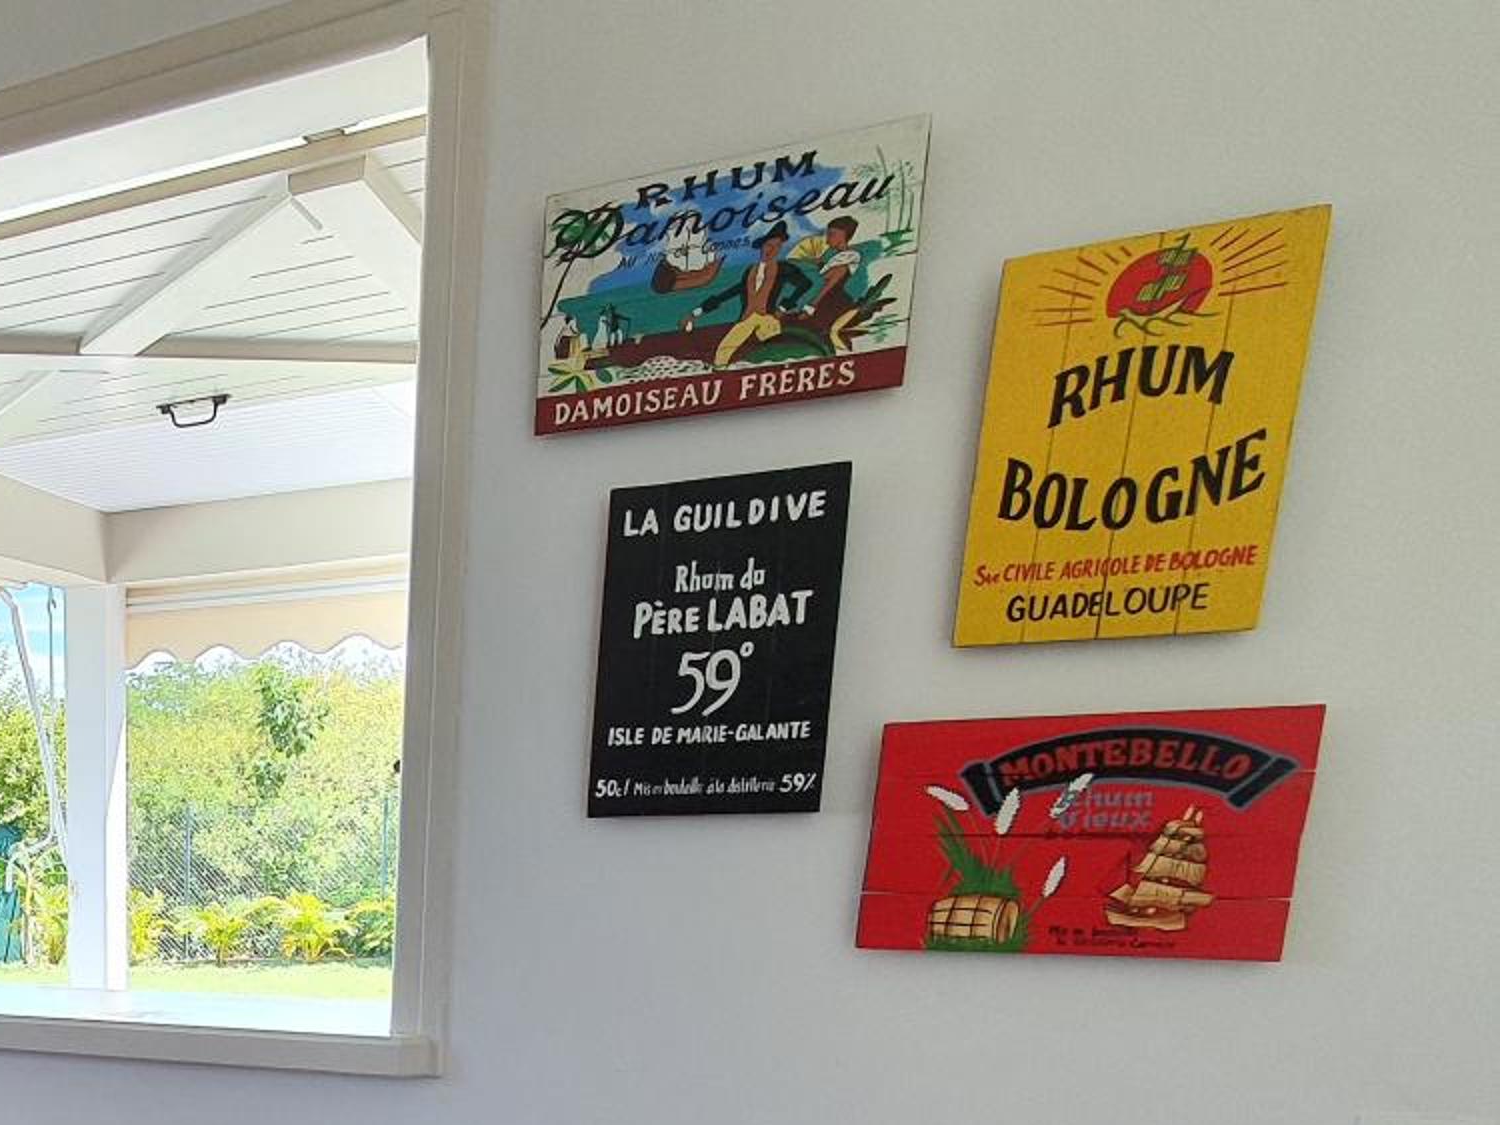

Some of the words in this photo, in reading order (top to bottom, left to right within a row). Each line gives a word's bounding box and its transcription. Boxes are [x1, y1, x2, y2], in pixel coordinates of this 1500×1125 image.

[635, 150, 818, 210] RHUM
[556, 174, 896, 262] Damoiseau
[554, 380, 722, 426] DAMOISEAU
[739, 360, 857, 400] FRÈRES
[1047, 345, 1235, 429] RHUM
[997, 428, 1268, 531] BOLOGNE
[623, 507, 660, 537] LA
[673, 489, 828, 533] GUILDIVE
[1003, 561, 1056, 583] CIVILE
[1059, 554, 1141, 579] AGRICOLE
[1143, 552, 1168, 573] DE
[1168, 545, 1259, 571] BOLOGNE
[633, 600, 700, 639] PÈRE
[707, 589, 814, 632] LABAT
[1006, 583, 1211, 623] GUADELOUPE
[671, 641, 755, 716] 59°
[608, 727, 645, 747] ISLE
[651, 726, 673, 745] DE
[676, 720, 812, 745] MARIE-GALANTE
[1001, 736, 1254, 788] MONTEBELLO
